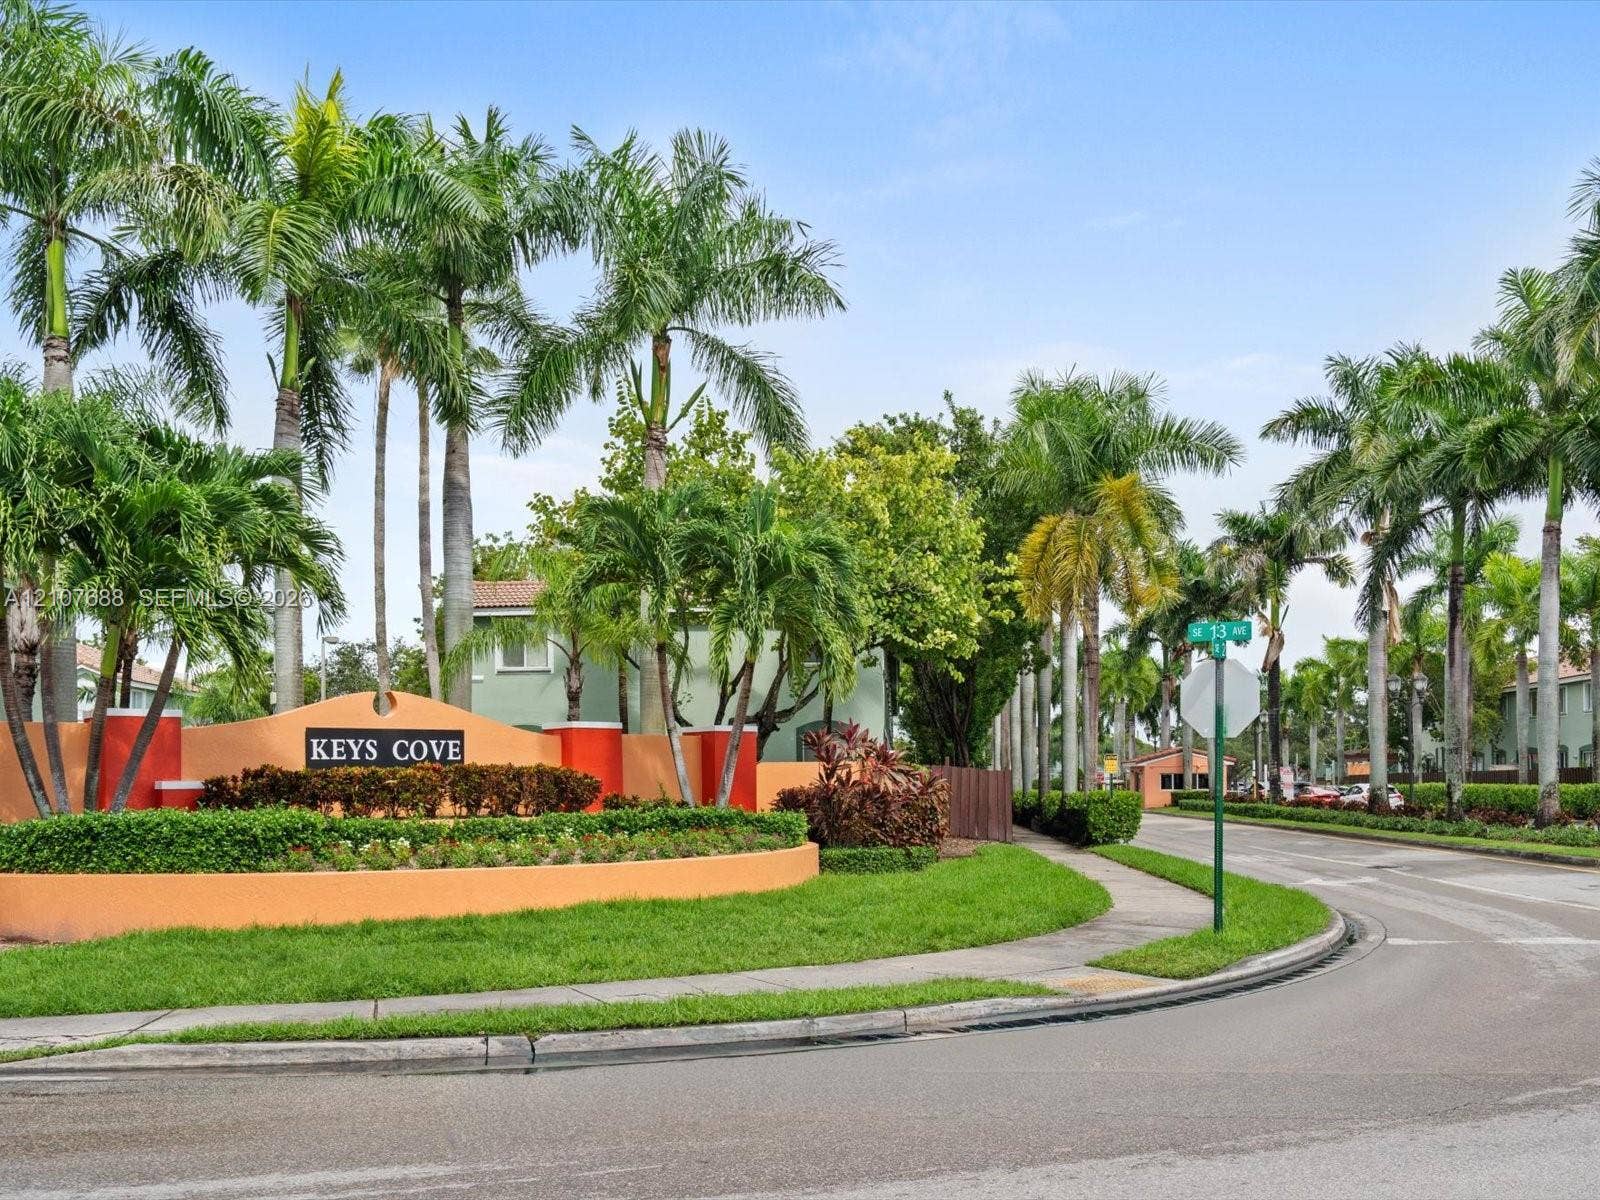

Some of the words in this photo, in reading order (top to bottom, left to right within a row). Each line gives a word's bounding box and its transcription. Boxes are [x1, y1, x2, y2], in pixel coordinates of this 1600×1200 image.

[1192, 627, 1203, 637] SE
[1209, 624, 1227, 639] 13
[1232, 625, 1248, 637] AVE
[310, 738, 378, 761] KEYS
[392, 739, 461, 761] COVE
